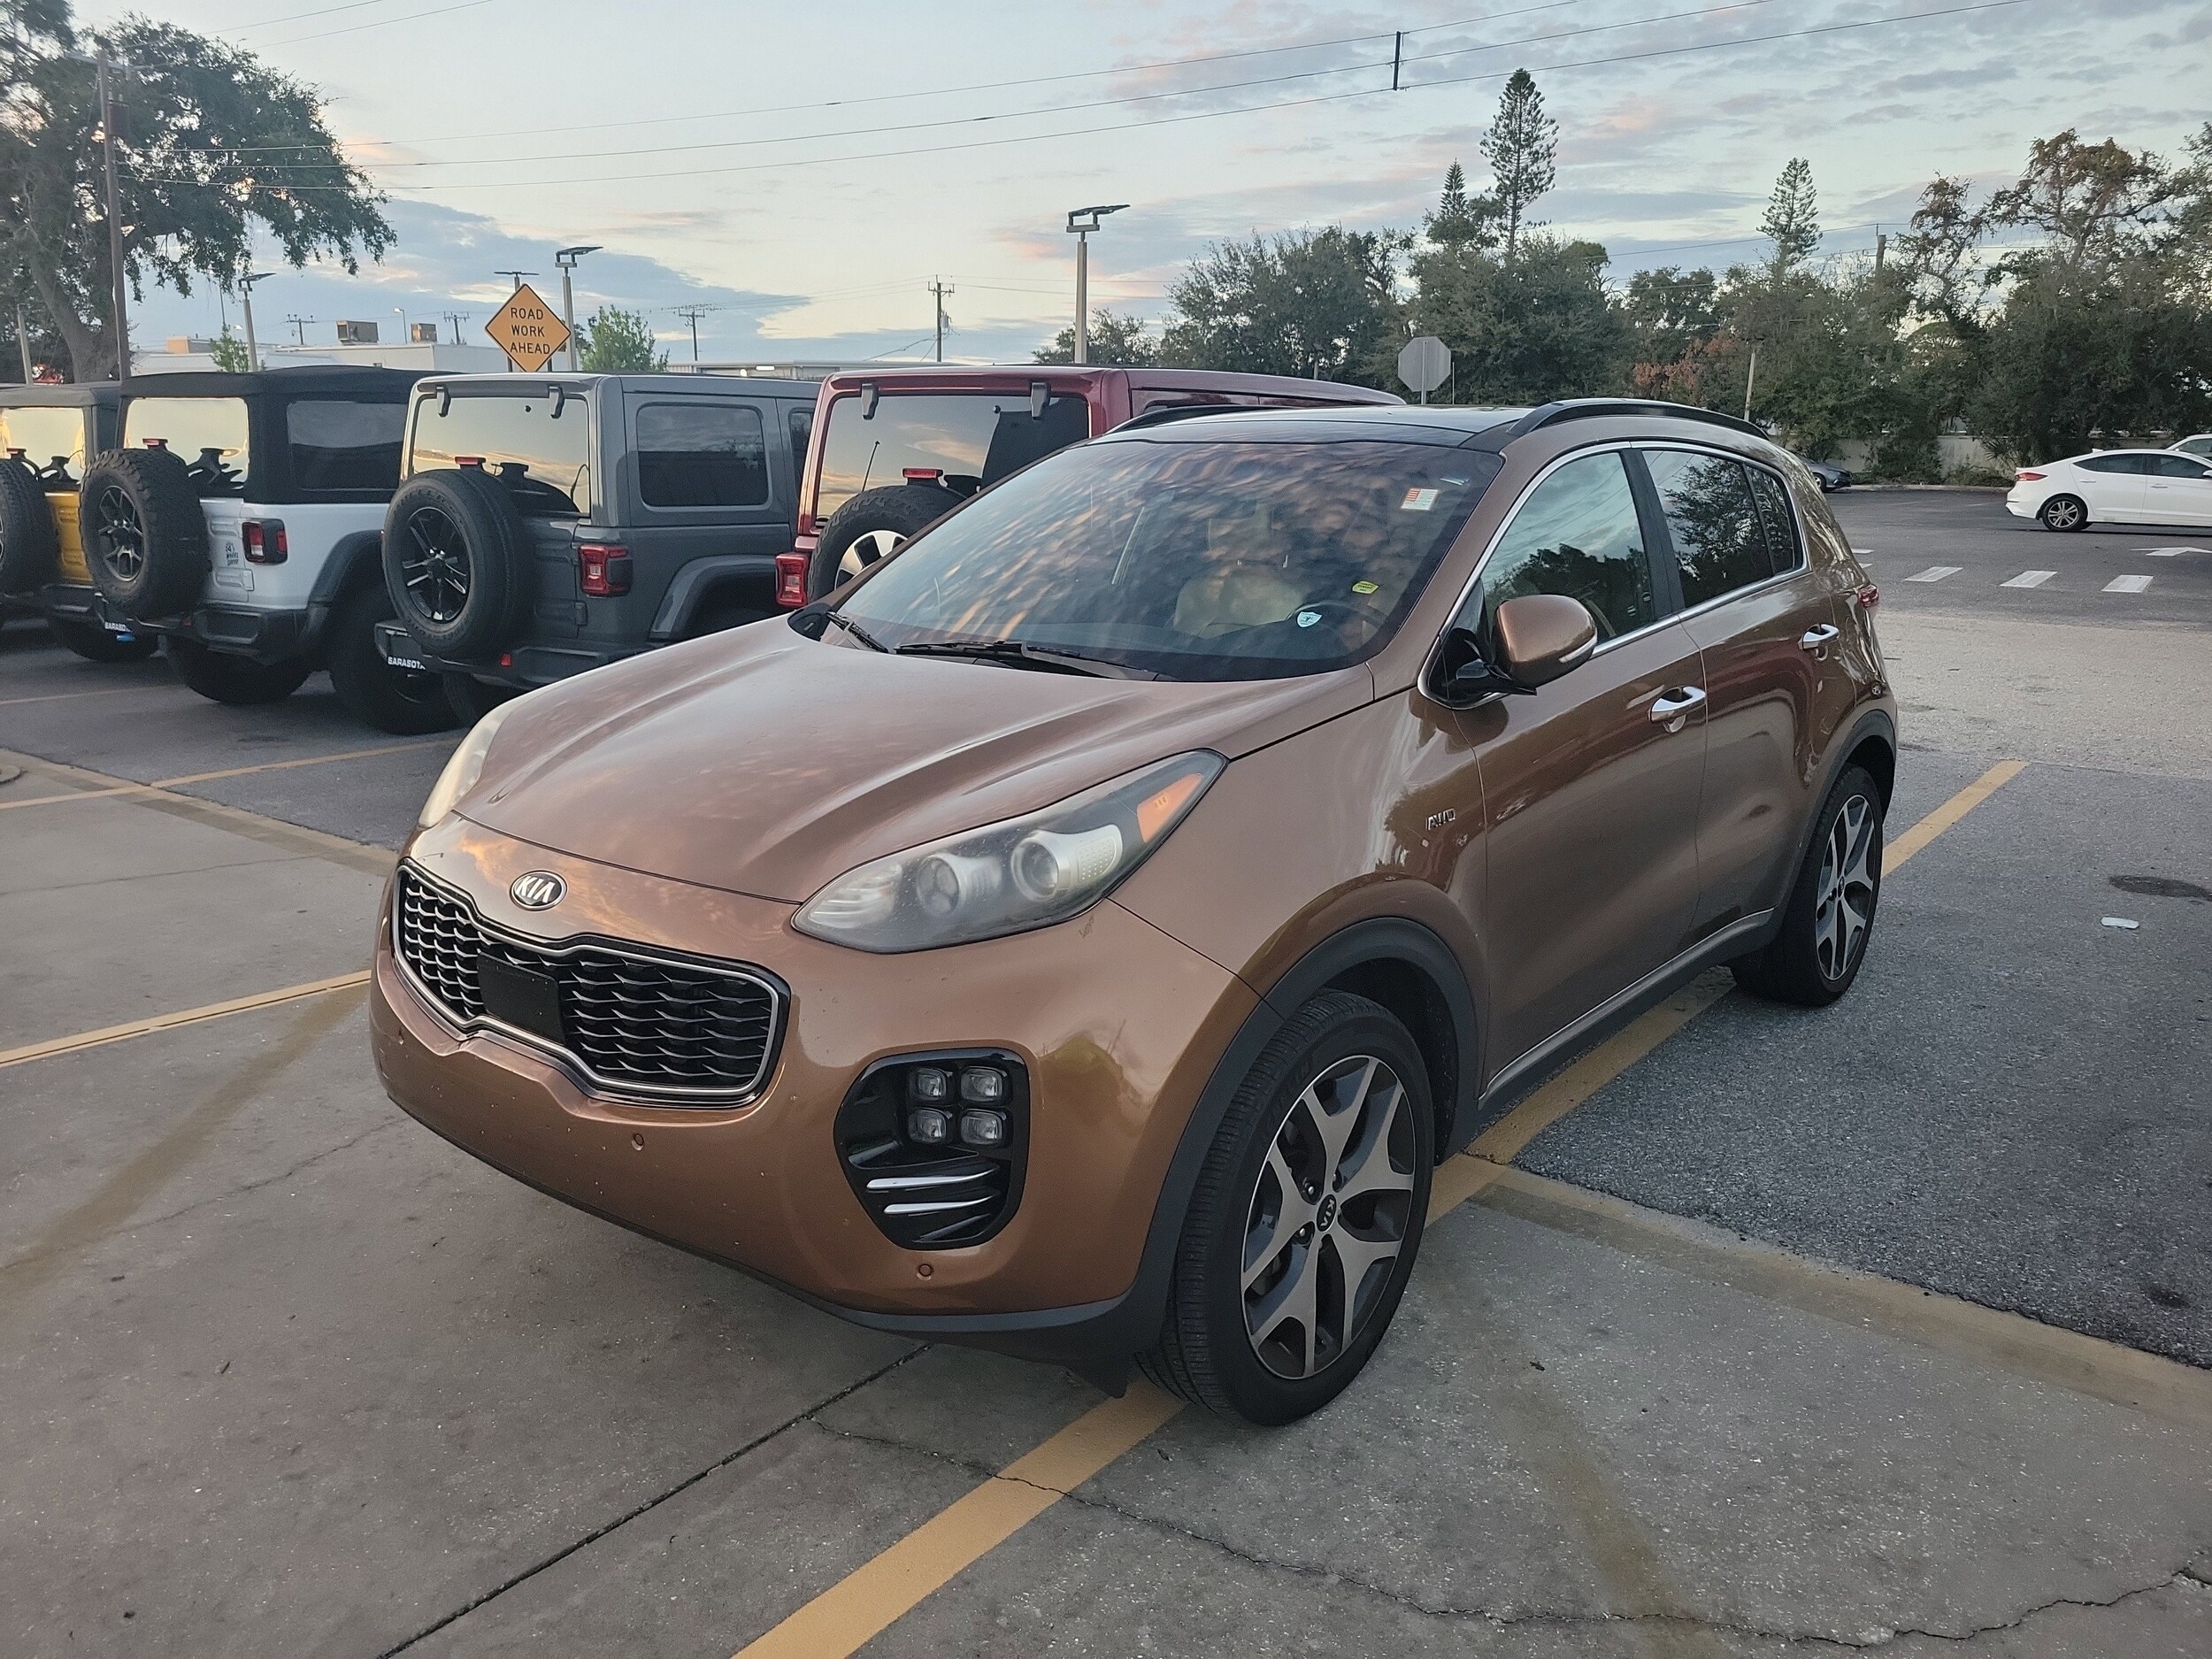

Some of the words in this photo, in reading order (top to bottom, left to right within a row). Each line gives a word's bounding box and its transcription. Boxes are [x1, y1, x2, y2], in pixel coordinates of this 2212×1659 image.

[511, 307, 543, 319] ROAD
[511, 324, 545, 337] WORK
[510, 342, 550, 354] AHEAD
[1425, 808, 1456, 831] AWD
[516, 876, 556, 903] KIA
[1320, 1198, 1335, 1226] KIA
